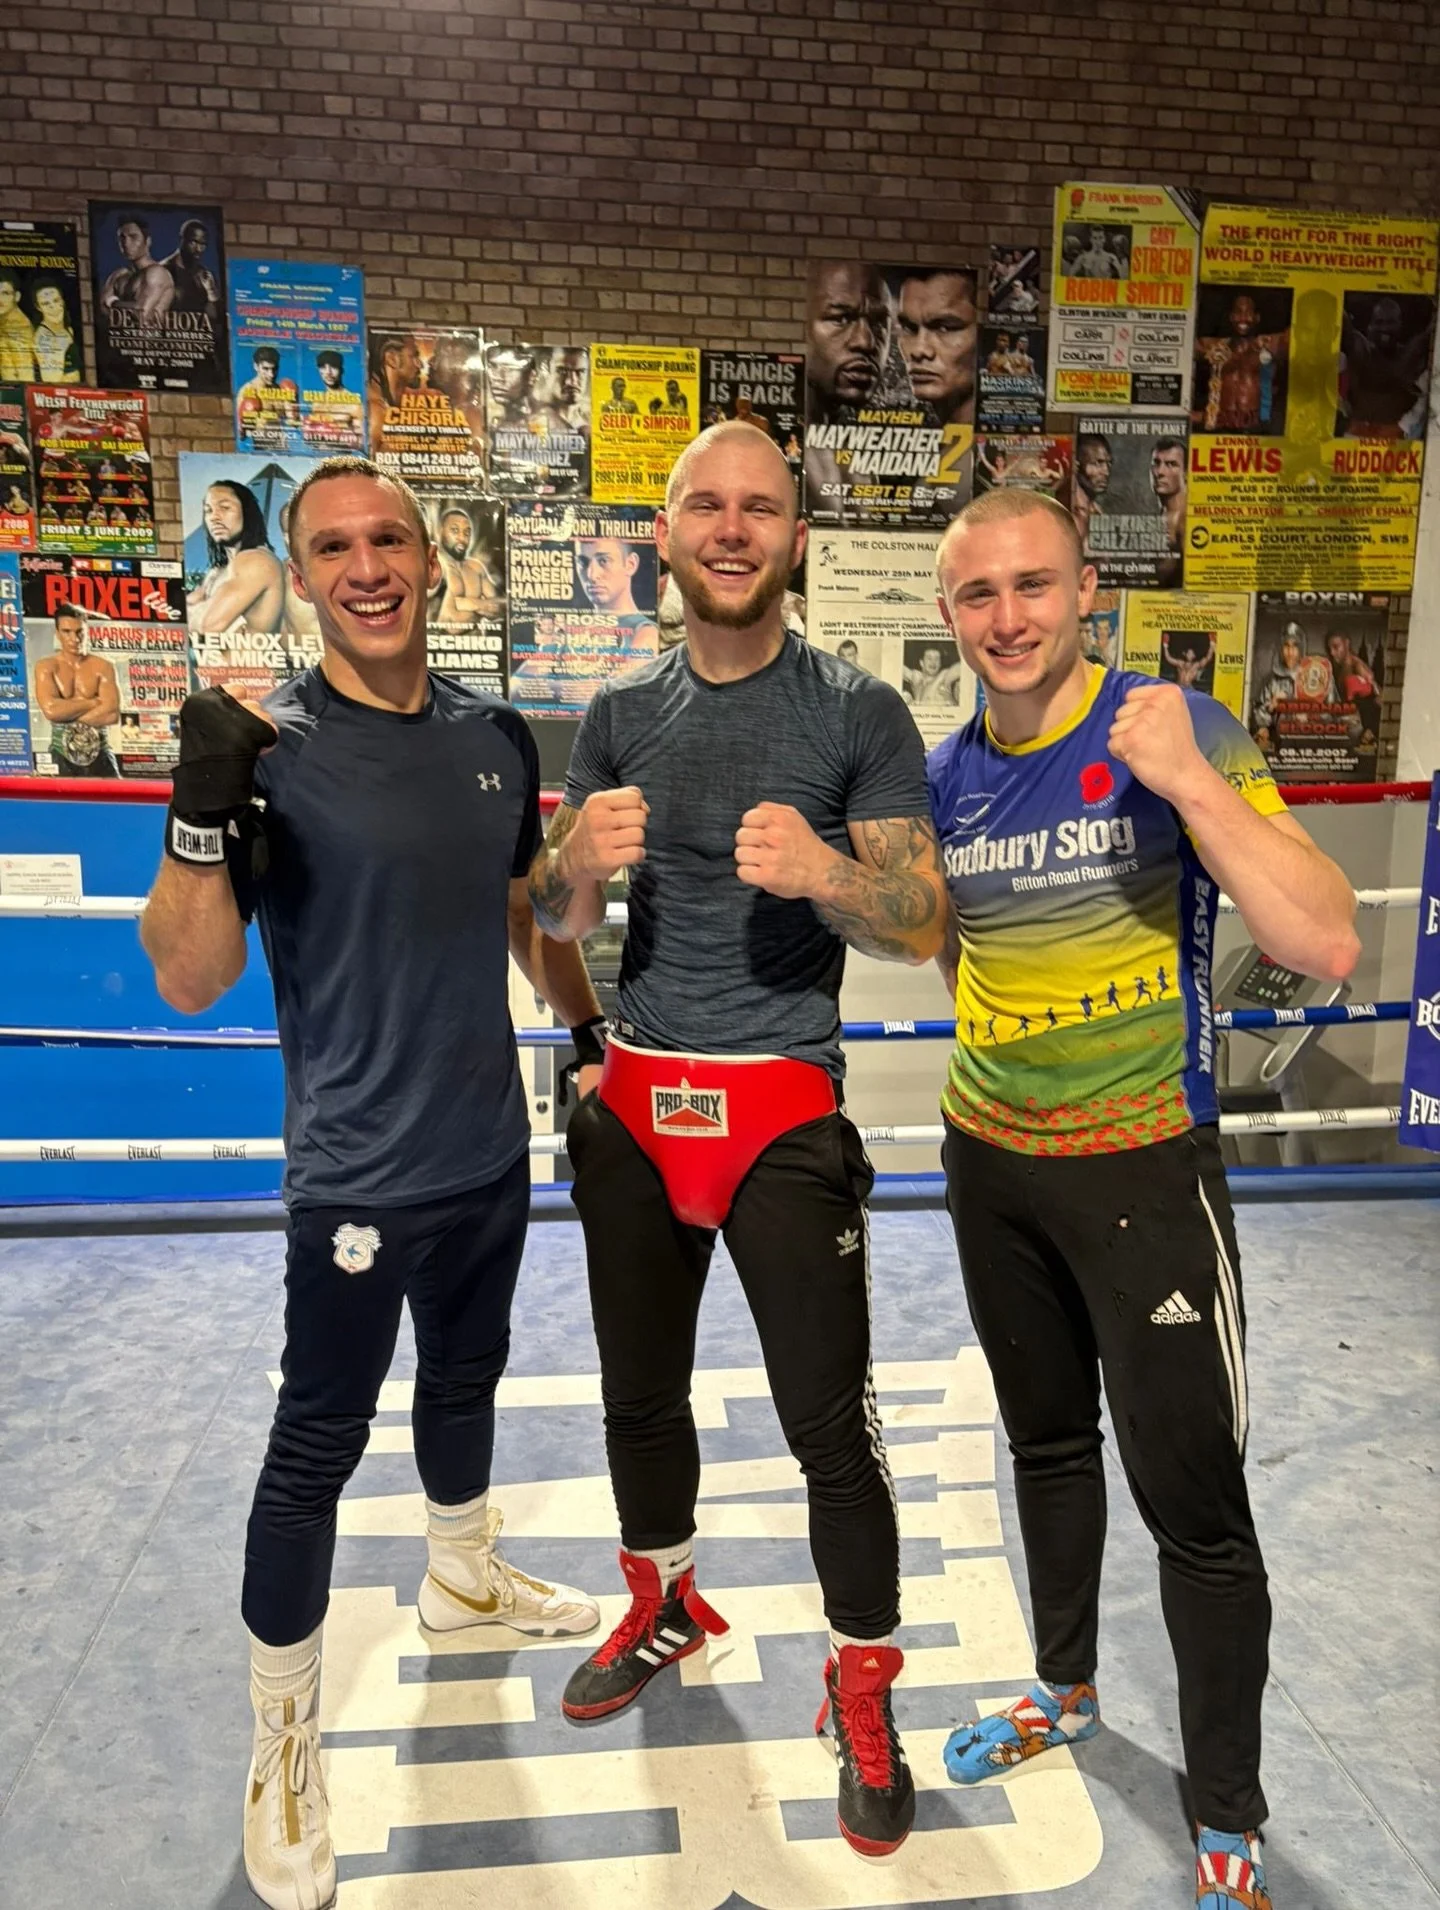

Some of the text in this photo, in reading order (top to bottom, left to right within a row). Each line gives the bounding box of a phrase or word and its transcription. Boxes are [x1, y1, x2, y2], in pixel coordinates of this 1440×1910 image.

[1220, 224, 1251, 239] THE
[1256, 227, 1301, 241] FIGHT
[1307, 230, 1337, 244] FOR
[1343, 232, 1372, 245] THE
[1377, 233, 1424, 248] RIGHT
[1132, 247, 1192, 276] STRETCH
[1204, 247, 1264, 262] WORLD
[1270, 249, 1387, 268] HEAVYWEIGHT
[1065, 276, 1183, 306] ROBIN SMITH
[165, 311, 214, 332] HOYA
[109, 339, 215, 352] HOMECOMING
[595, 358, 696, 373] CHAMPIONSHIP BOXING
[709, 359, 796, 383] FRANCIS
[401, 393, 451, 408] HAYE
[709, 381, 796, 405] IS BACK
[384, 406, 470, 427] CHISORA
[602, 414, 690, 431] SELBY SIMPSON
[858, 409, 924, 424] MAYHEM
[1080, 420, 1114, 435] BATTLE
[1132, 422, 1149, 435] THE
[1152, 423, 1186, 436] PLANET
[1216, 437, 1260, 446] LENNOX
[376, 451, 400, 465] BOX
[805, 424, 974, 484] MAYWEATHER 2
[1191, 447, 1420, 474] LEWIS RUDDOCK
[836, 450, 940, 477] VS MAIDANA
[820, 484, 850, 496] SAT
[853, 485, 894, 498] SEPT
[1231, 485, 1257, 493] PLUS
[41, 524, 81, 535] FRIDAY
[95, 525, 120, 537] JUNE
[124, 526, 153, 537] 2009
[851, 540, 915, 551] THE COLSTON
[1211, 534, 1255, 543] EARLS
[1315, 534, 1376, 545] LONDON,
[511, 550, 573, 567] PRINCE
[511, 566, 573, 584] NASEEM
[46, 574, 169, 620] BOXEN
[511, 582, 574, 600] HAMED
[1285, 591, 1364, 606] BOXEN
[566, 615, 618, 626] ROSS
[844, 622, 899, 630] WELTERWEIGHT
[89, 626, 185, 644] MARKUS BEYER
[192, 631, 282, 651] LENNOX
[91, 639, 185, 651] VS GLENN CATLEY
[231, 651, 287, 668] MIKE
[1125, 651, 1244, 665] LENNOX LEWIS
[1280, 747, 1348, 758] 08.12.2007
[176, 826, 219, 856] TUF-WEAR
[944, 815, 1136, 879] Sodbury Slog
[1012, 858, 1139, 893] Bitton Road Runners
[1193, 876, 1212, 1074] EASY RUNNER
[656, 1092, 722, 1123] PRO BOX
[40, 1144, 247, 1161] EVERLAST EVERLAST EVERLAST
[1150, 1310, 1201, 1325] adidas
